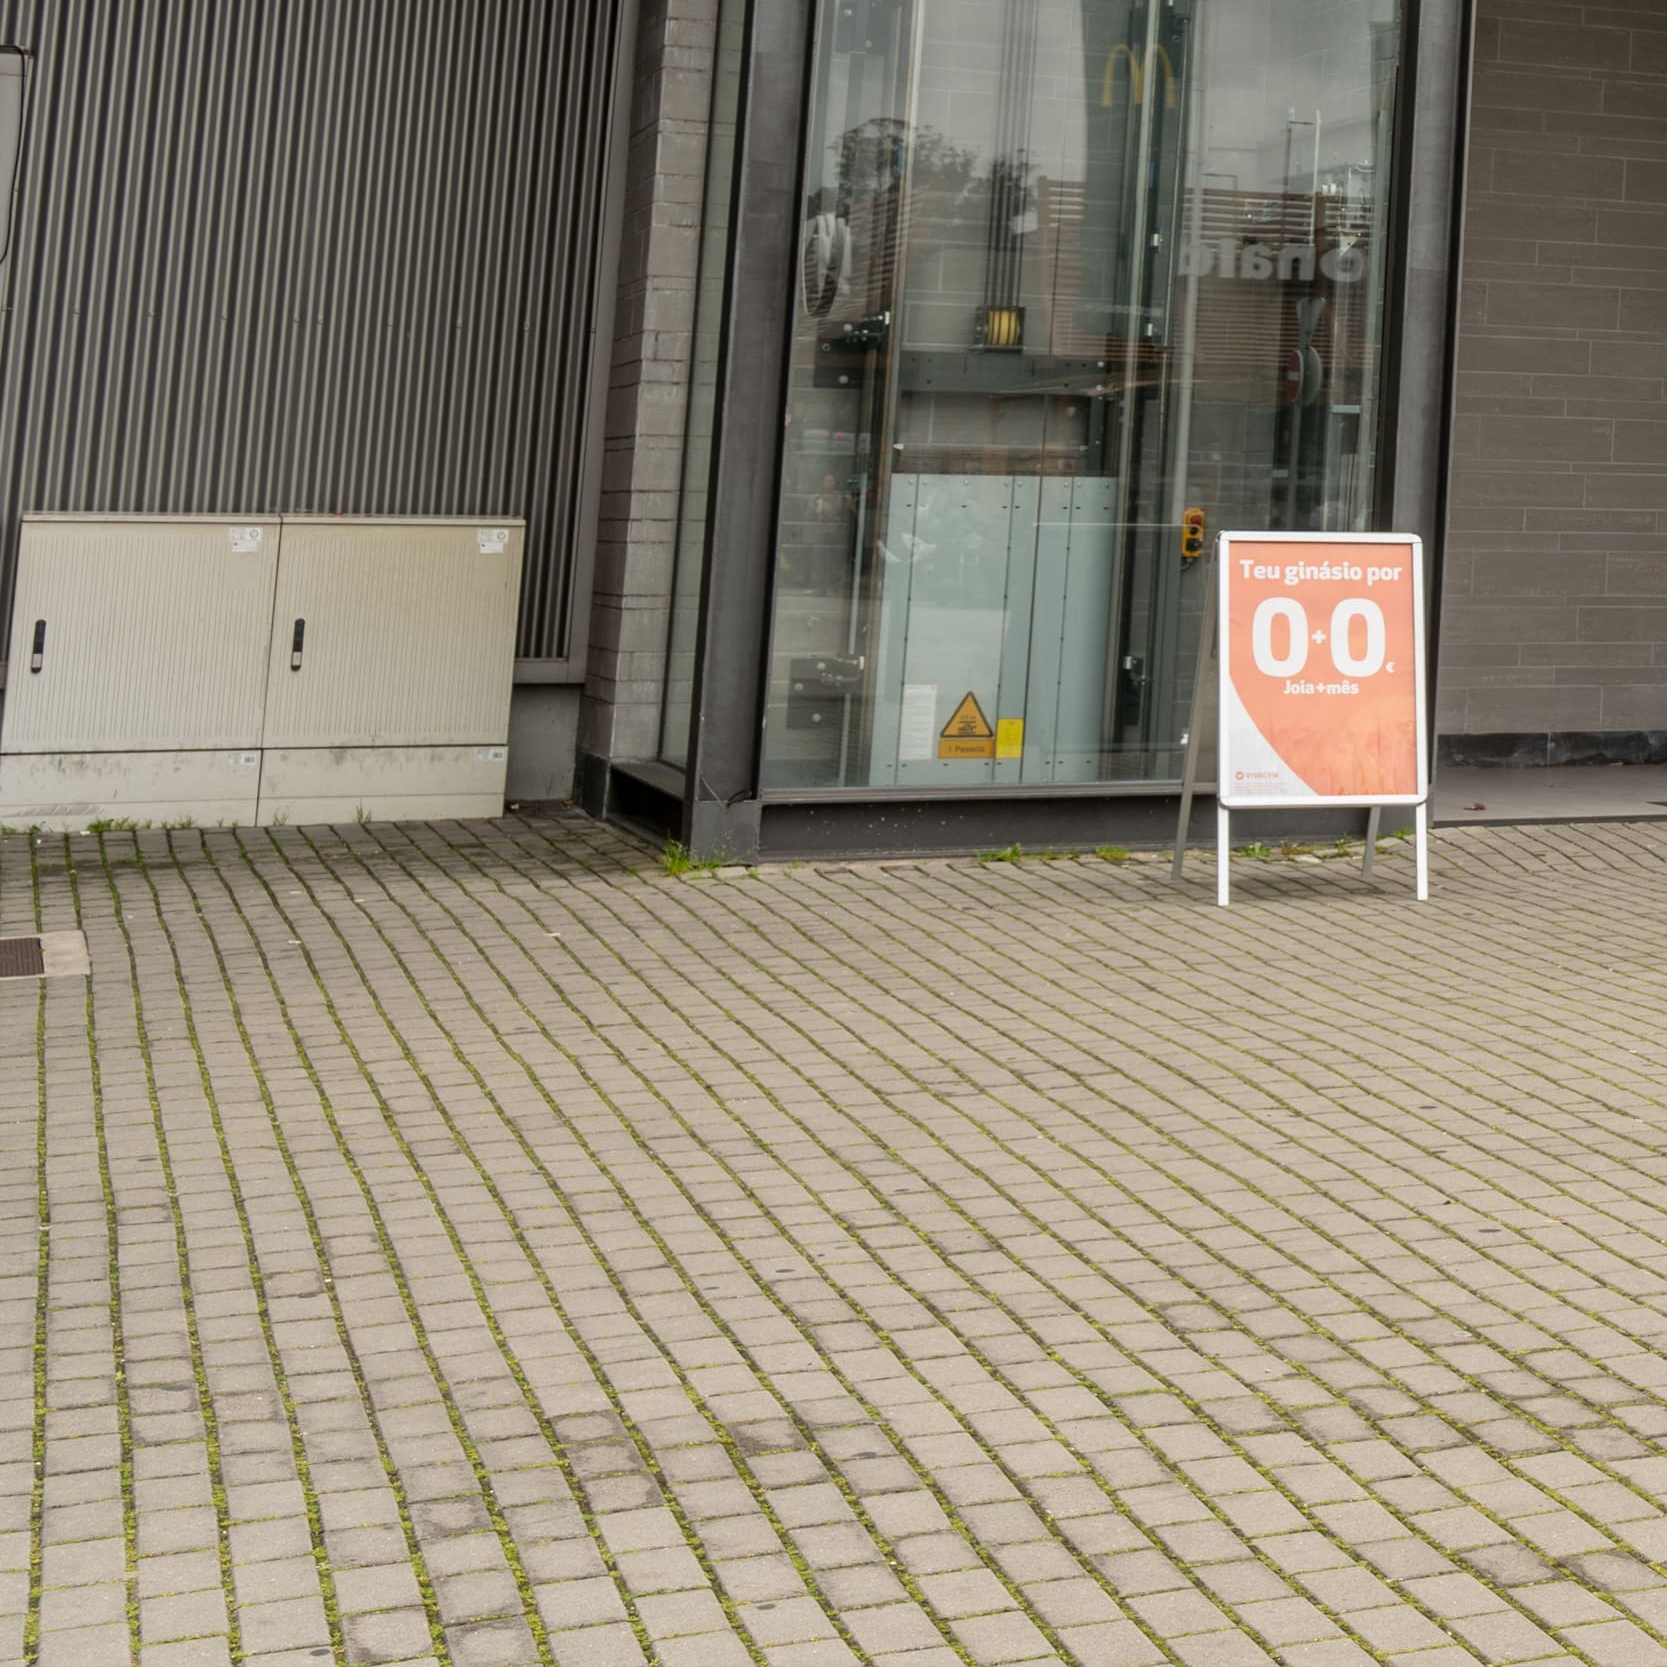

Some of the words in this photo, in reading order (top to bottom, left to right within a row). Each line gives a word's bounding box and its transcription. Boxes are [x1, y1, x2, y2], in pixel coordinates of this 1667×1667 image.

[1239, 559, 1281, 579] Teu
[1284, 560, 1363, 585] ginásio
[1367, 566, 1403, 586] por
